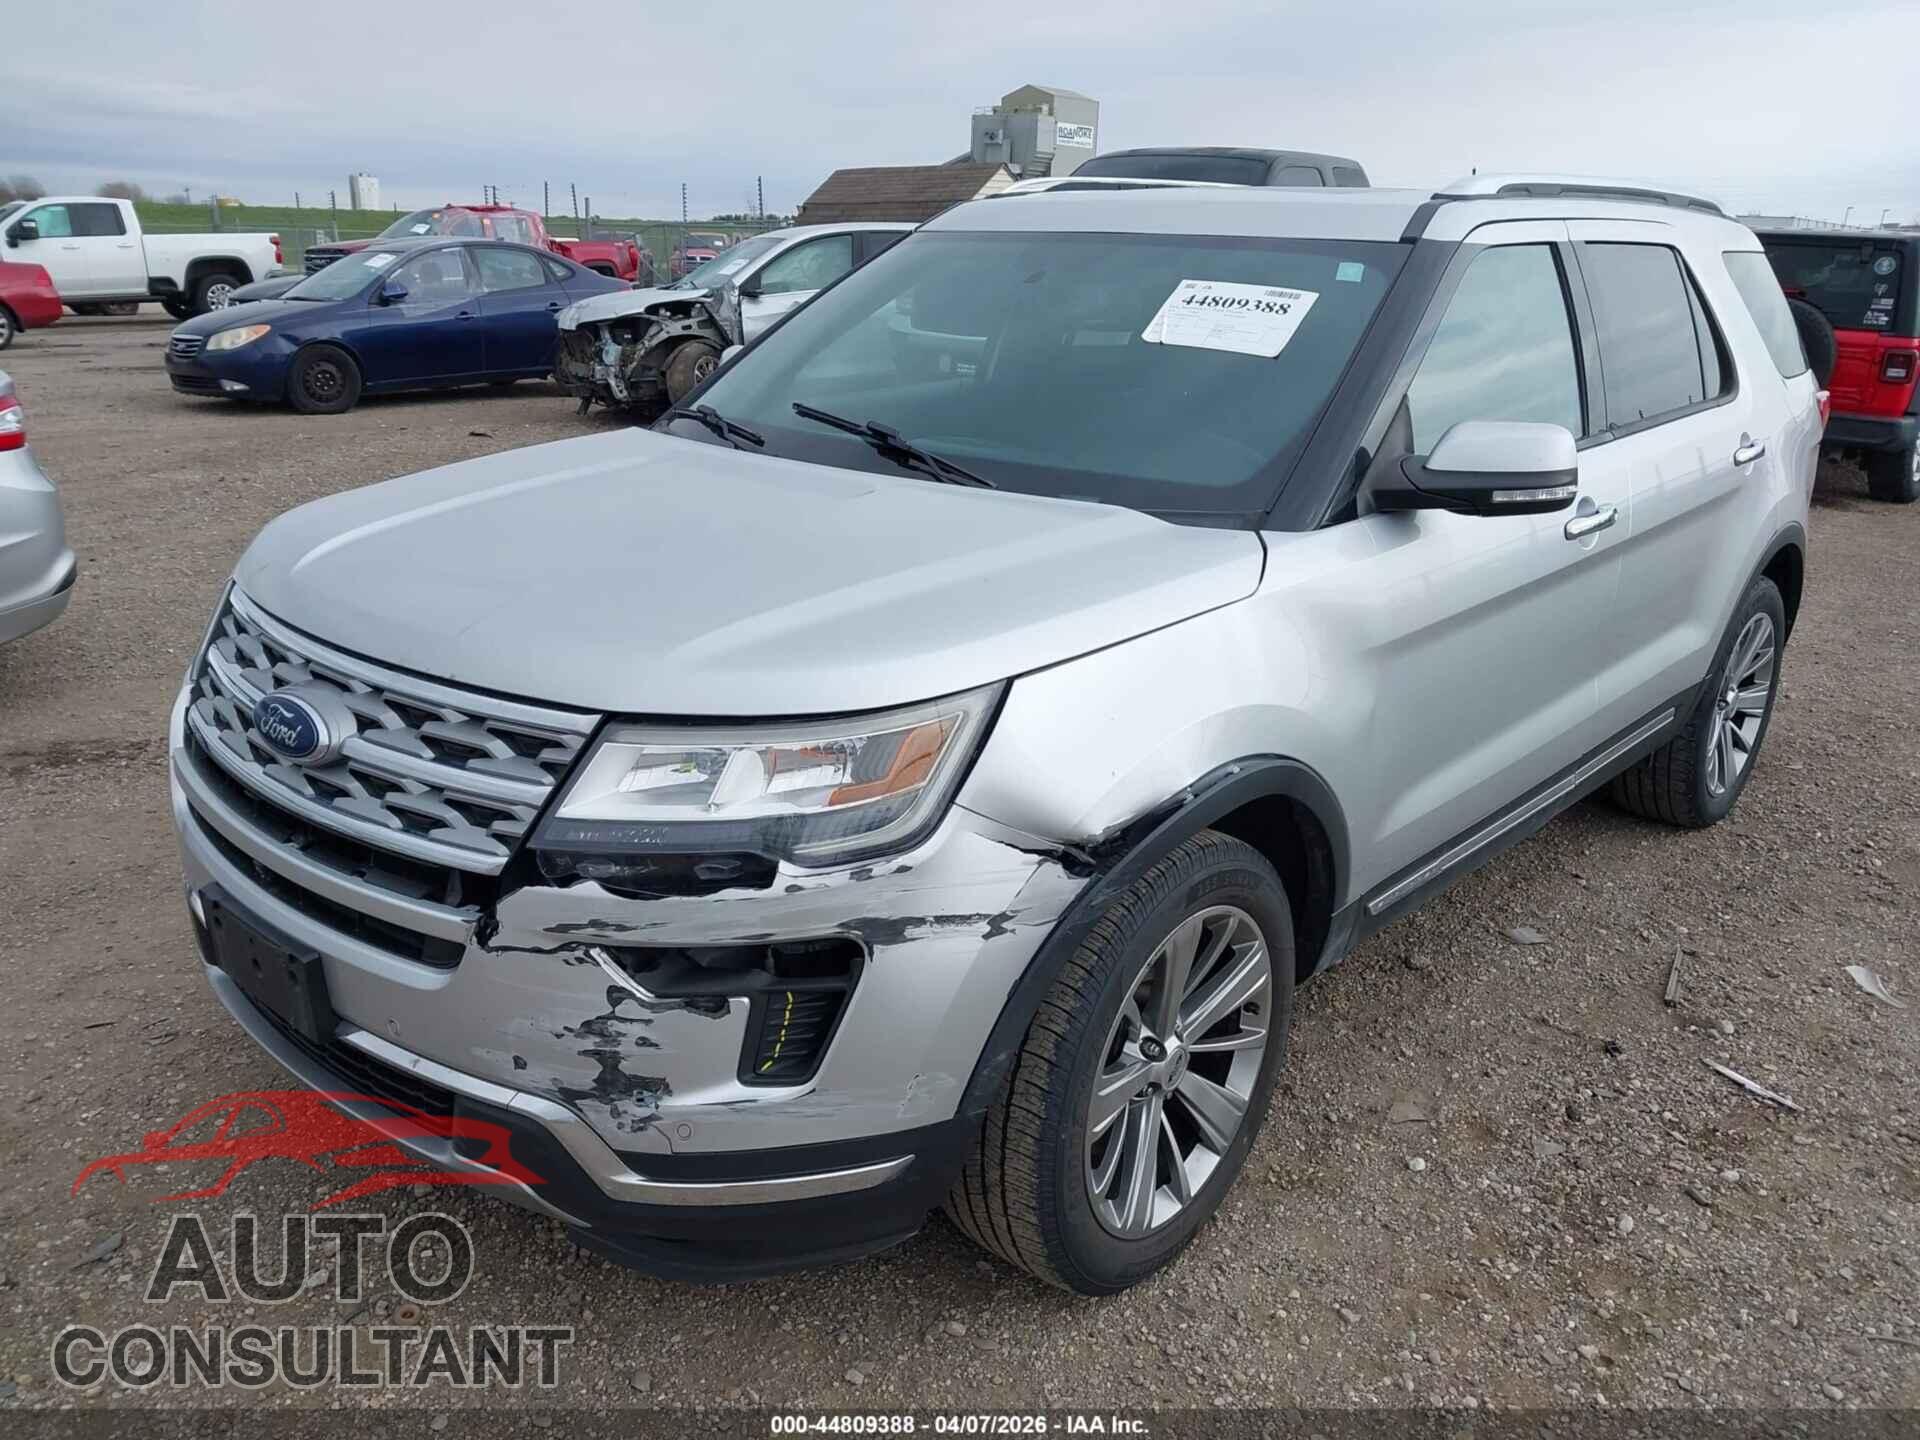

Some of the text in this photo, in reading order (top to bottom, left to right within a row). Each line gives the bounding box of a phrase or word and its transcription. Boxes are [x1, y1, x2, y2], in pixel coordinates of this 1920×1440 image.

[1058, 126, 1092, 139] ROANOKE
[1182, 294, 1291, 316] 44809388
[260, 703, 303, 748] Ford
